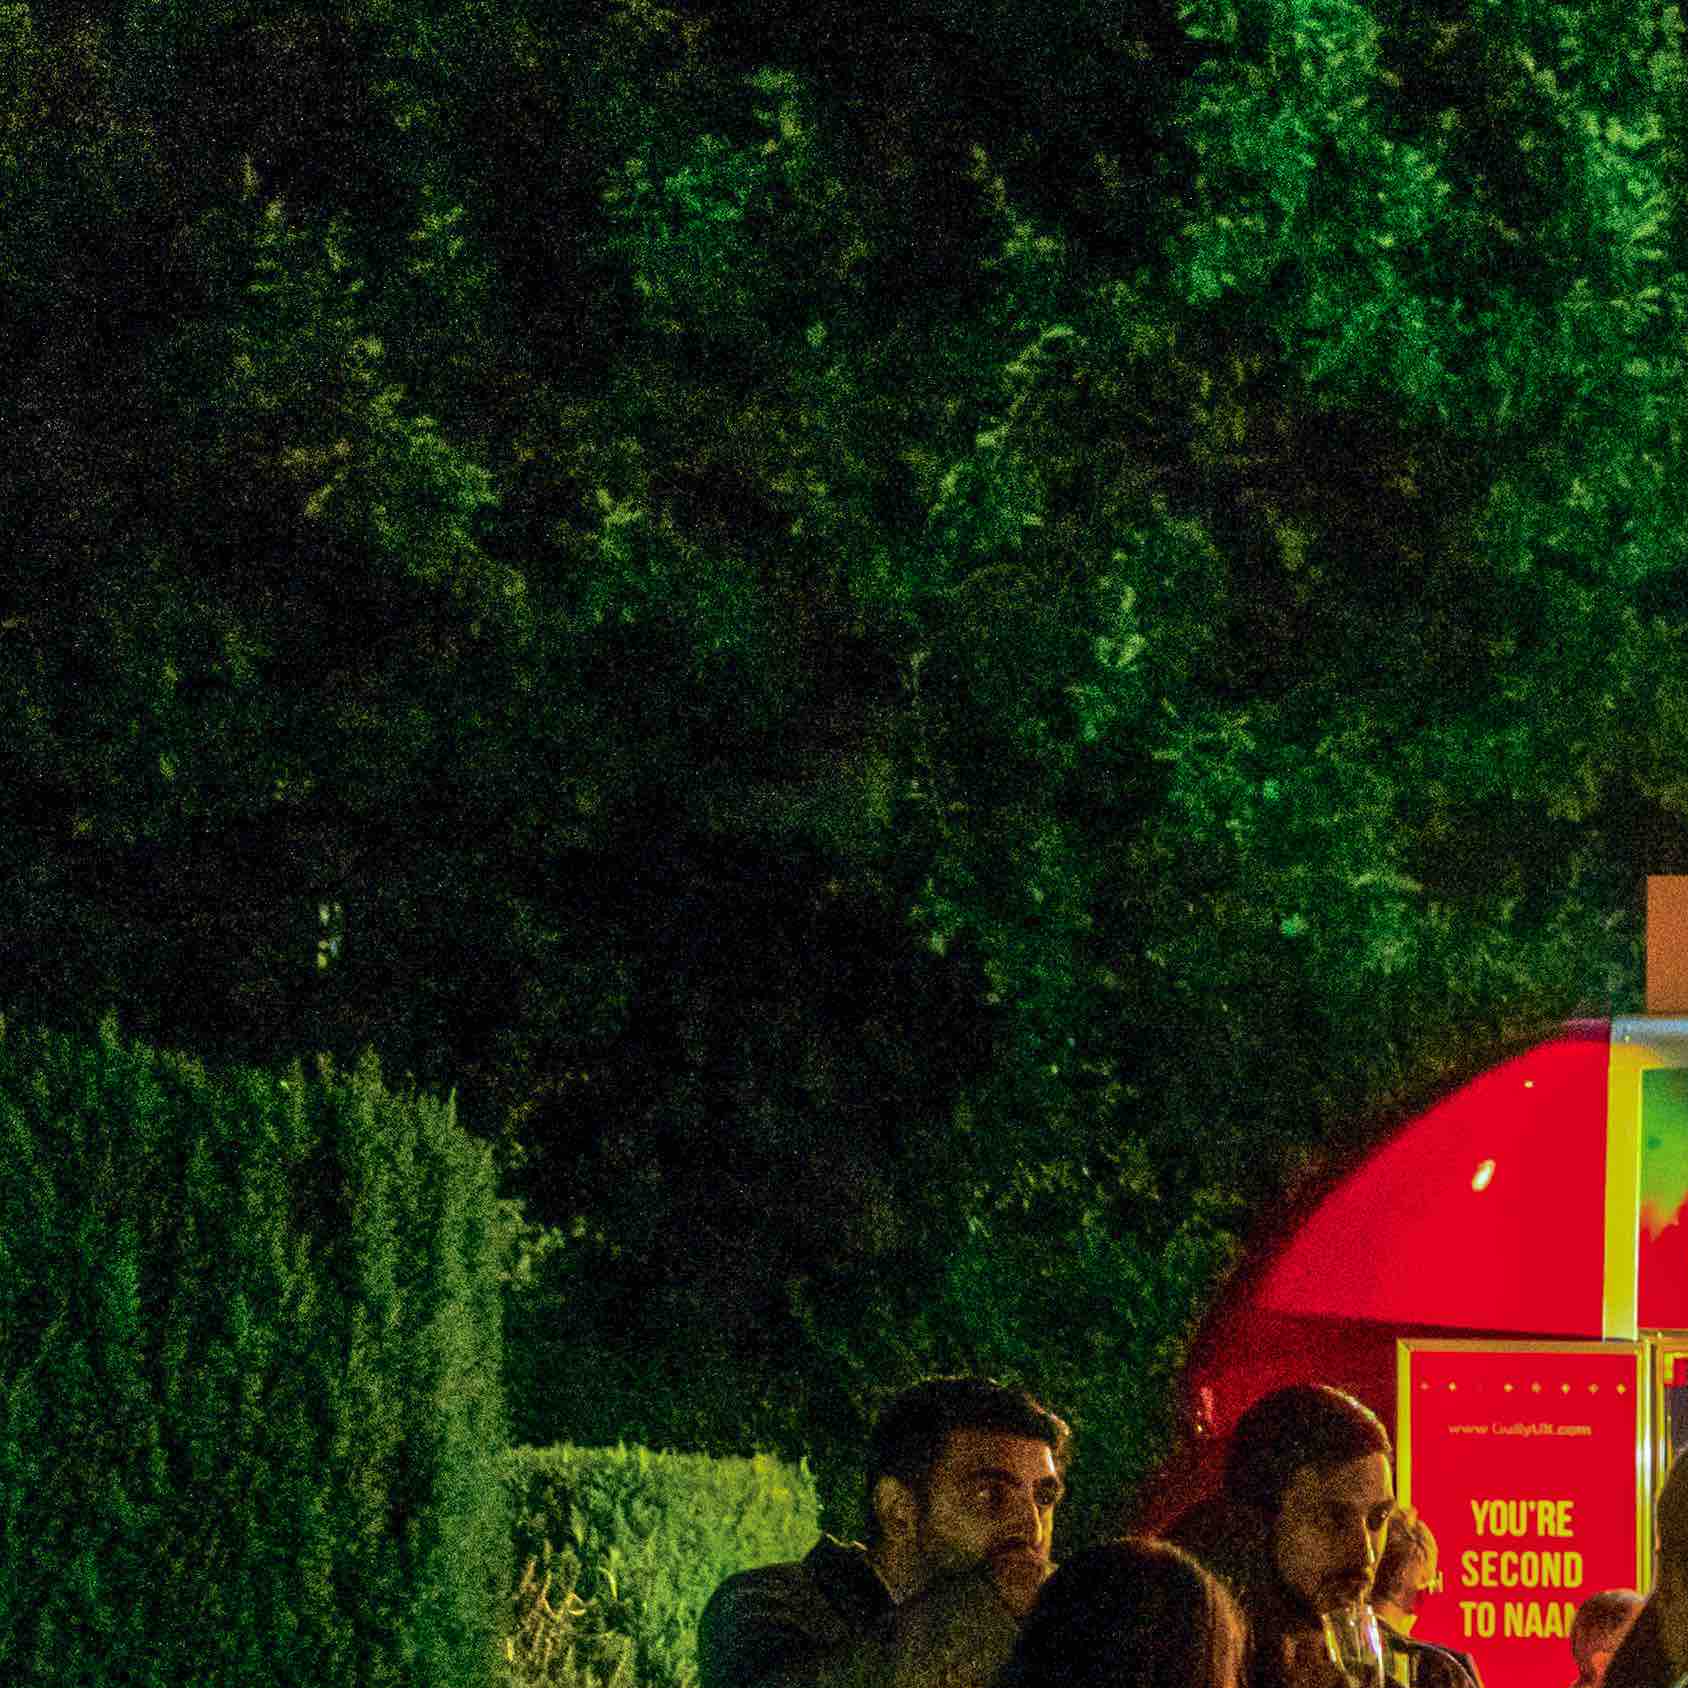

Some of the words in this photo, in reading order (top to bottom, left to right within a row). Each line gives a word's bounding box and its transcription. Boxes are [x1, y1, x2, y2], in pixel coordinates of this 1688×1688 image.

[1470, 1499, 1575, 1537] YOU'RE
[1460, 1550, 1584, 1588] SECOND
[1458, 1601, 1497, 1638] TO
